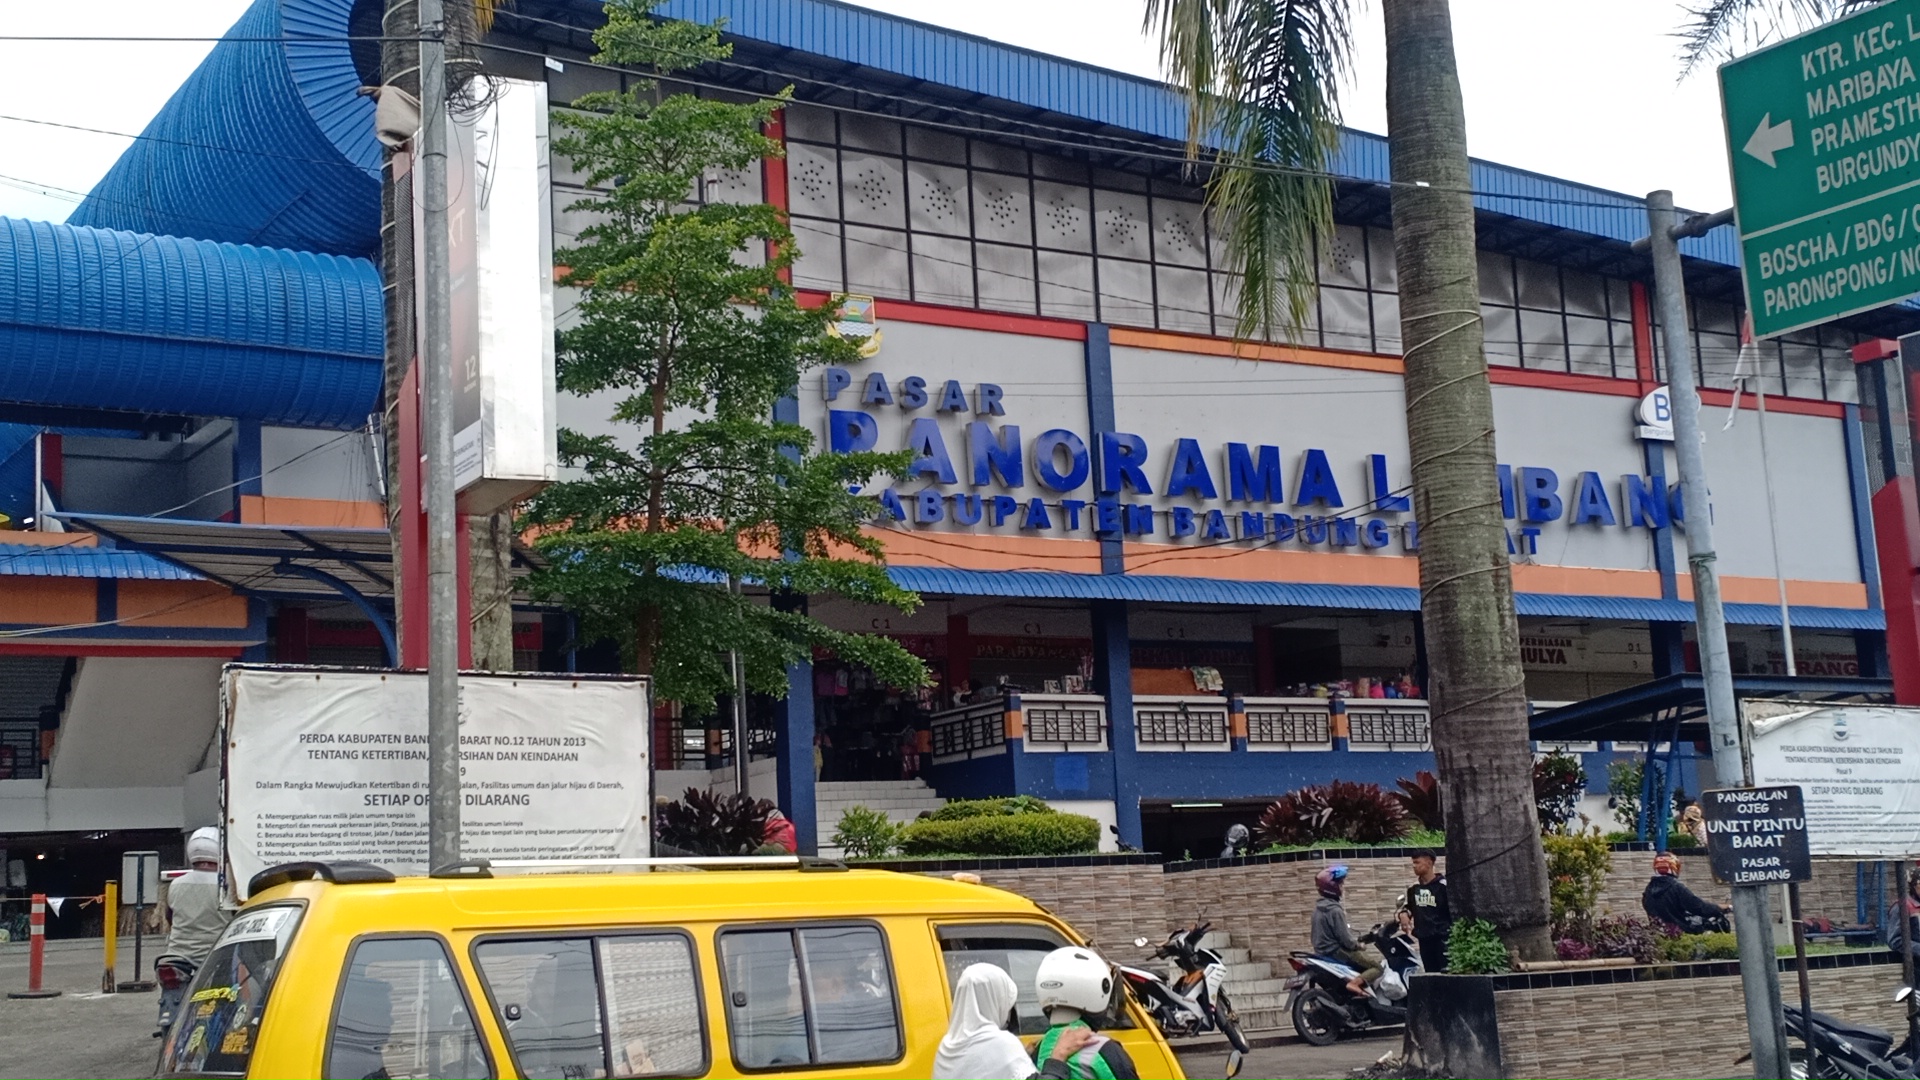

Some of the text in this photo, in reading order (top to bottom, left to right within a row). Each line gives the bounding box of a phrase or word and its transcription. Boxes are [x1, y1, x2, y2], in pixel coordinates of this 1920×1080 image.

[1801, 42, 1849, 81] KTR.
[1853, 21, 1902, 61] KEC.
[1806, 56, 1915, 119] MARIBAYA
[1816, 133, 1920, 194] BURGUNDY
[822, 368, 1005, 416] PASAR
[826, 408, 1714, 530] PANORAMA LBAN
[850, 487, 1154, 534] ABUPATEN
[1169, 506, 1389, 548] BANDUNG
[1766, 661, 1859, 675] TRANG
[300, 733, 586, 746] PERDA KABUPATEN BARAT NO.12 TAHUN 2013
[308, 750, 358, 760] TENTANG
[457, 751, 494, 761] RSIHAN
[497, 752, 518, 761] DAN
[521, 752, 578, 762] KEINDAHAN
[460, 767, 466, 776] 9
[256, 781, 282, 789] Dalam
[284, 781, 313, 790] Rangka
[315, 781, 367, 790] Mewujudkan
[370, 781, 410, 789] Ketertiban
[412, 781, 419, 789] di
[536, 781, 550, 789] dan
[551, 781, 568, 791] jalur
[569, 781, 587, 790] hijau
[588, 781, 595, 789] di
[597, 781, 624, 790] Daerah,
[1812, 786, 1883, 796] SETIAP ORANG DILARANG
[364, 794, 410, 806] SETIAP
[465, 794, 530, 806] DILARANG
[1717, 790, 1788, 803] PANGKALAN
[1737, 803, 1769, 813] OJEG
[265, 813, 317, 821] Mempergunakan
[1707, 820, 1751, 833] UNIT
[1753, 817, 1804, 832] PINTU
[1732, 834, 1785, 848] BARAT
[1742, 856, 1781, 868] PASAR
[1735, 869, 1791, 882] LEMBANG
